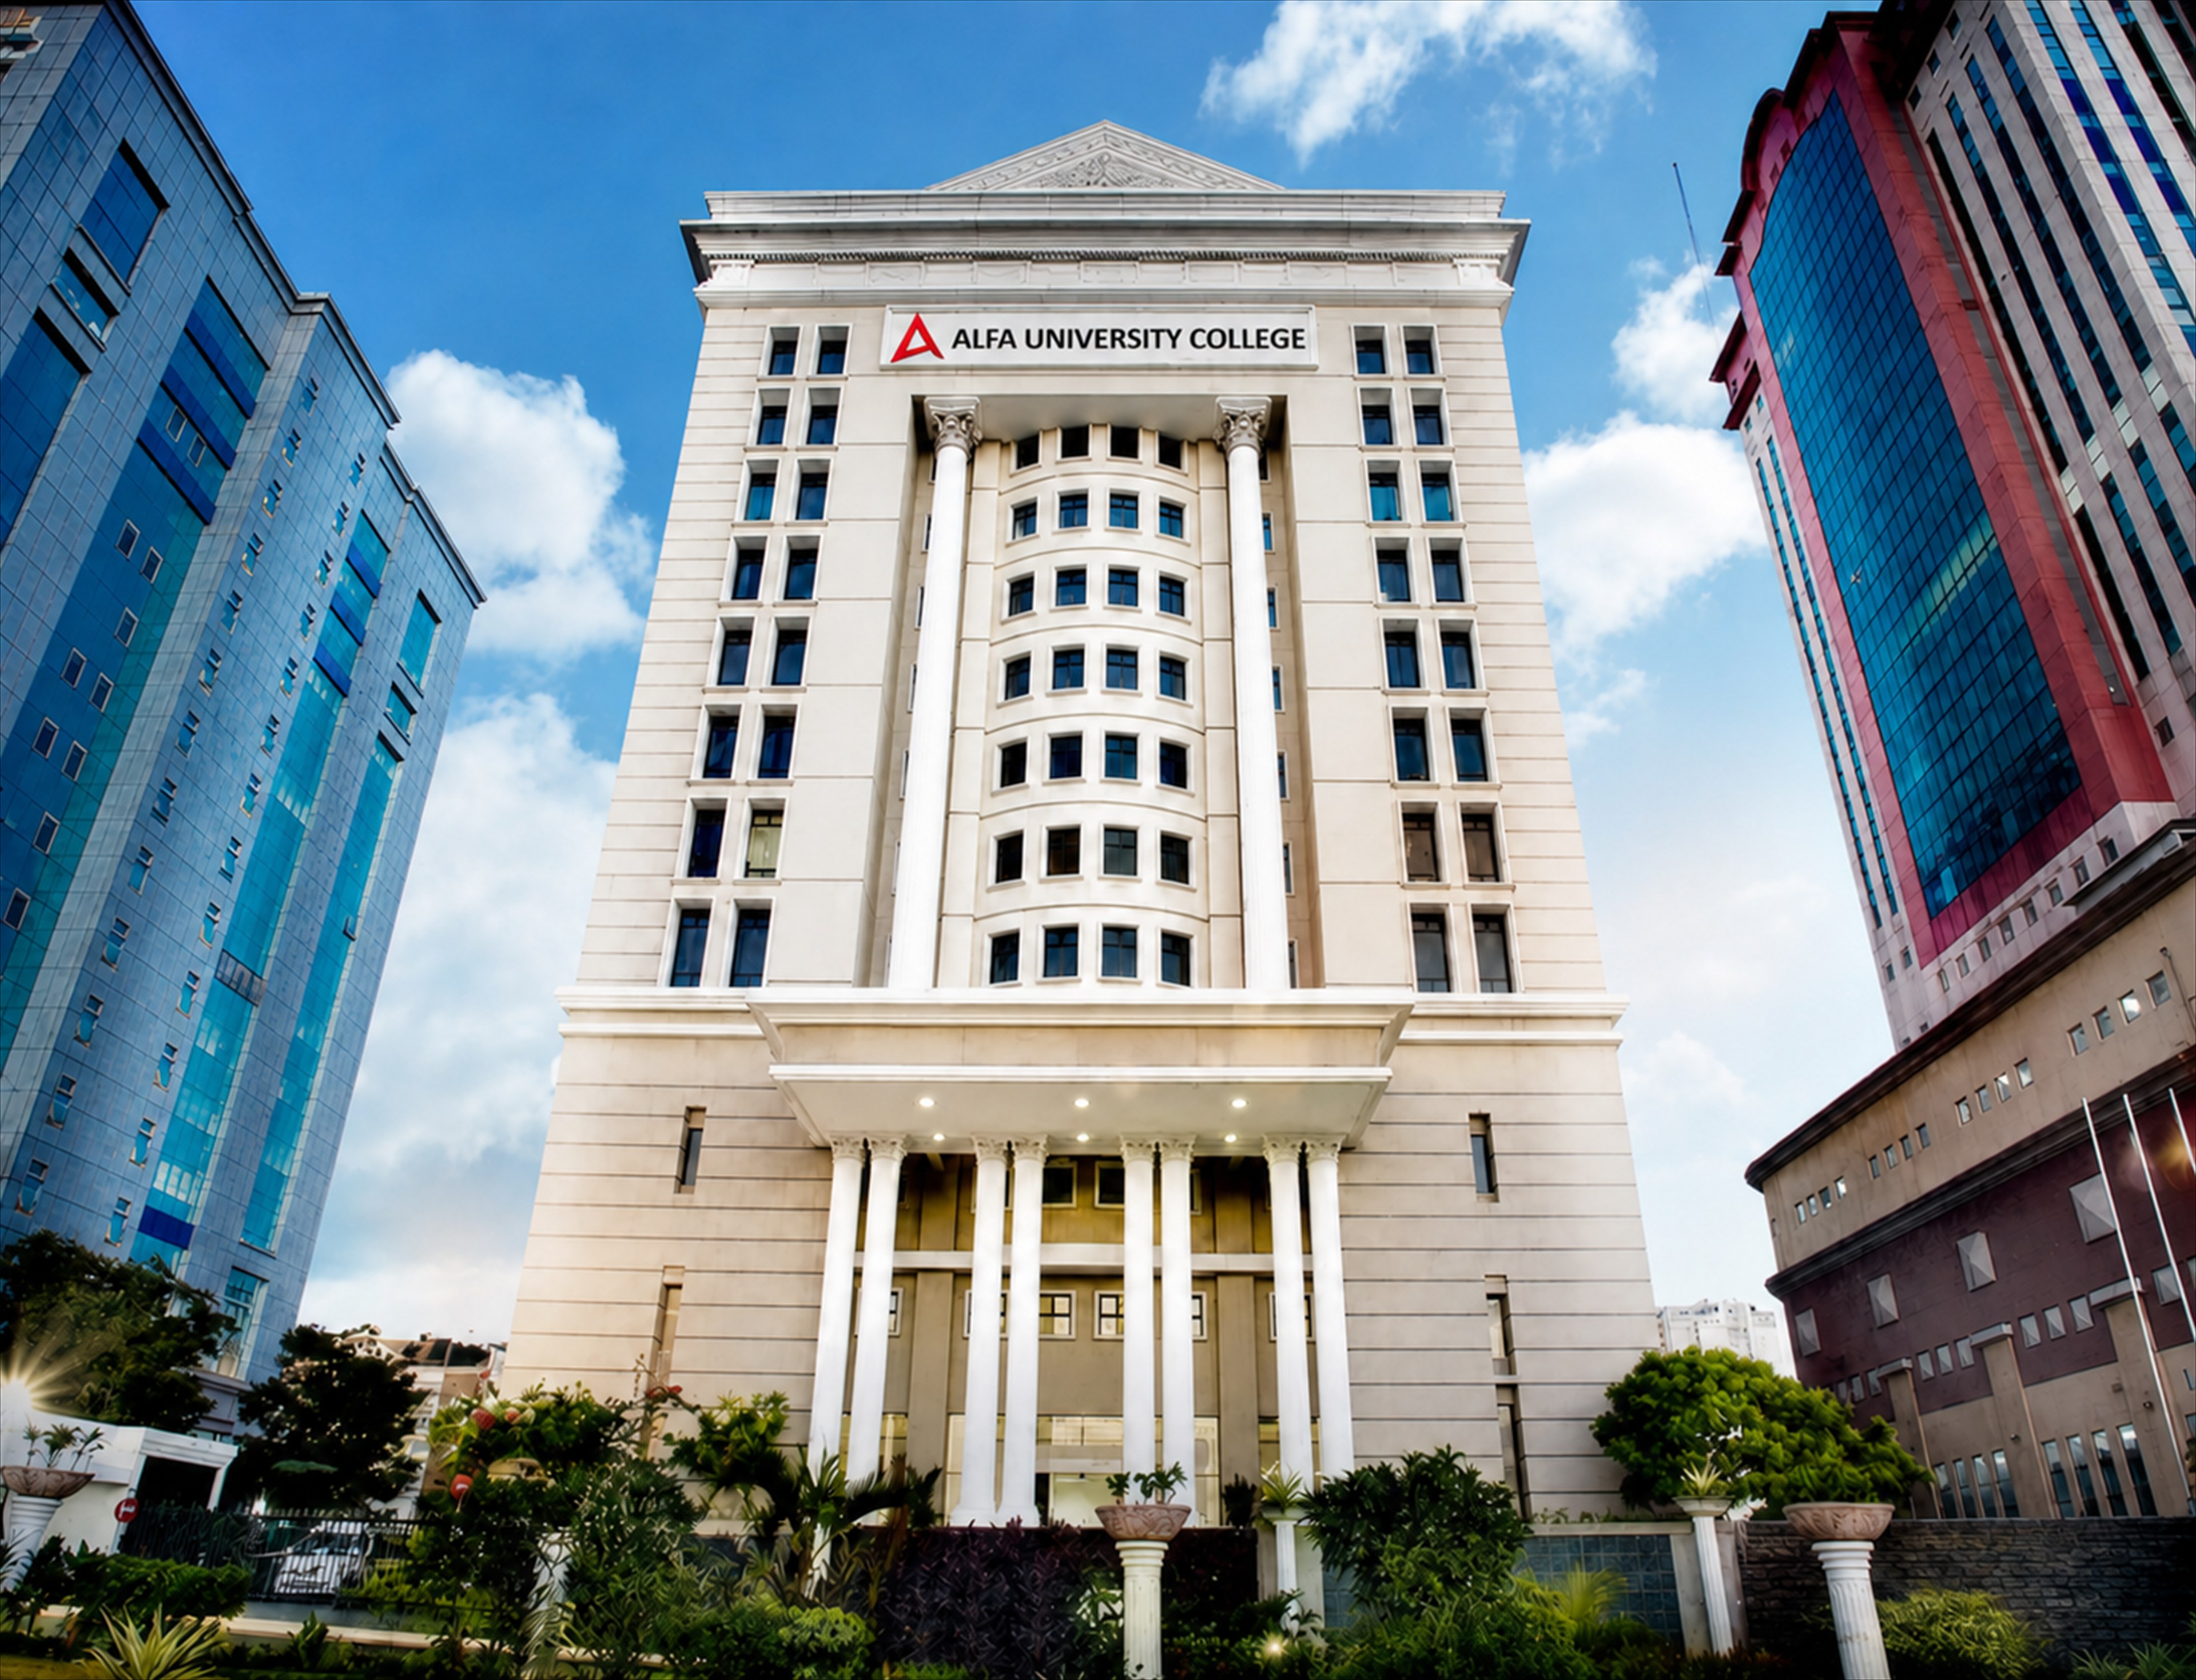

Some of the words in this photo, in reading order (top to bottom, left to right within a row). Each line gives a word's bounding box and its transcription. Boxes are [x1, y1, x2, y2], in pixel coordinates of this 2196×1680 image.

[952, 328, 1017, 349] ALFA
[1025, 328, 1182, 350] UNIVERSITY
[1190, 328, 1306, 350] COLLEGE
